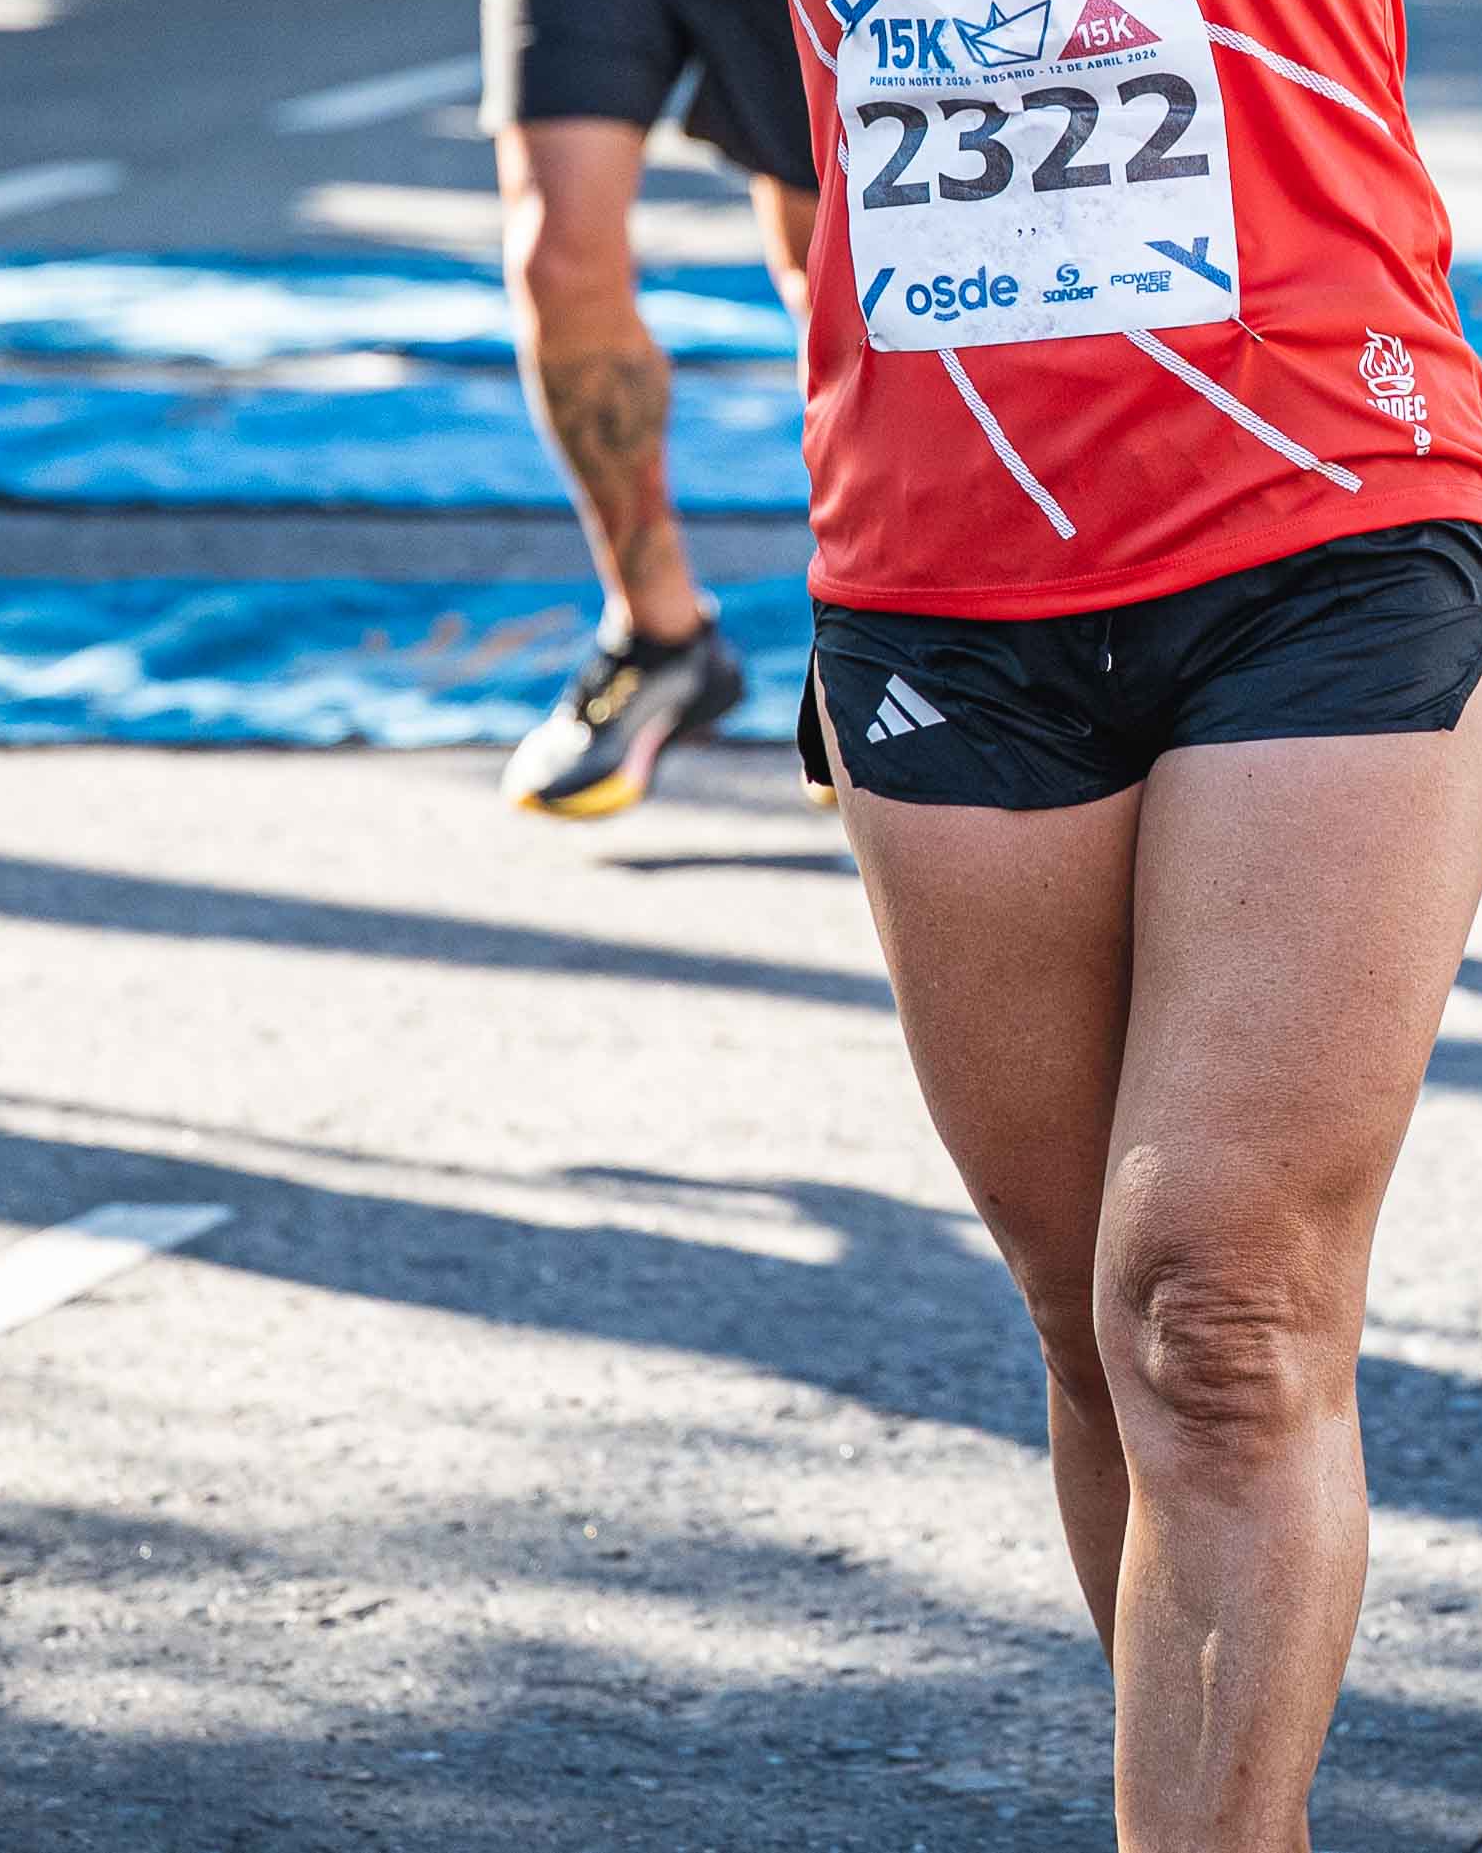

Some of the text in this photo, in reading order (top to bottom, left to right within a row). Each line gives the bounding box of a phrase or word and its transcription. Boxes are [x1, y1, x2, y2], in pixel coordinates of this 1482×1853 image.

[870, 19, 955, 71] 15K
[1076, 14, 1133, 49] 15K
[869, 75, 905, 86] PUERTO
[908, 75, 942, 86] NORTE
[982, 68, 1035, 85] ROSARIO
[1049, 66, 1063, 75] 12
[1067, 62, 1083, 72] DE
[1087, 55, 1123, 69] ABRIL
[1127, 49, 1157, 62] 2026
[856, 73, 1210, 210] 2322
[905, 265, 1019, 316] osde
[1110, 270, 1172, 287] POWER
[1136, 281, 1171, 295] ADE
